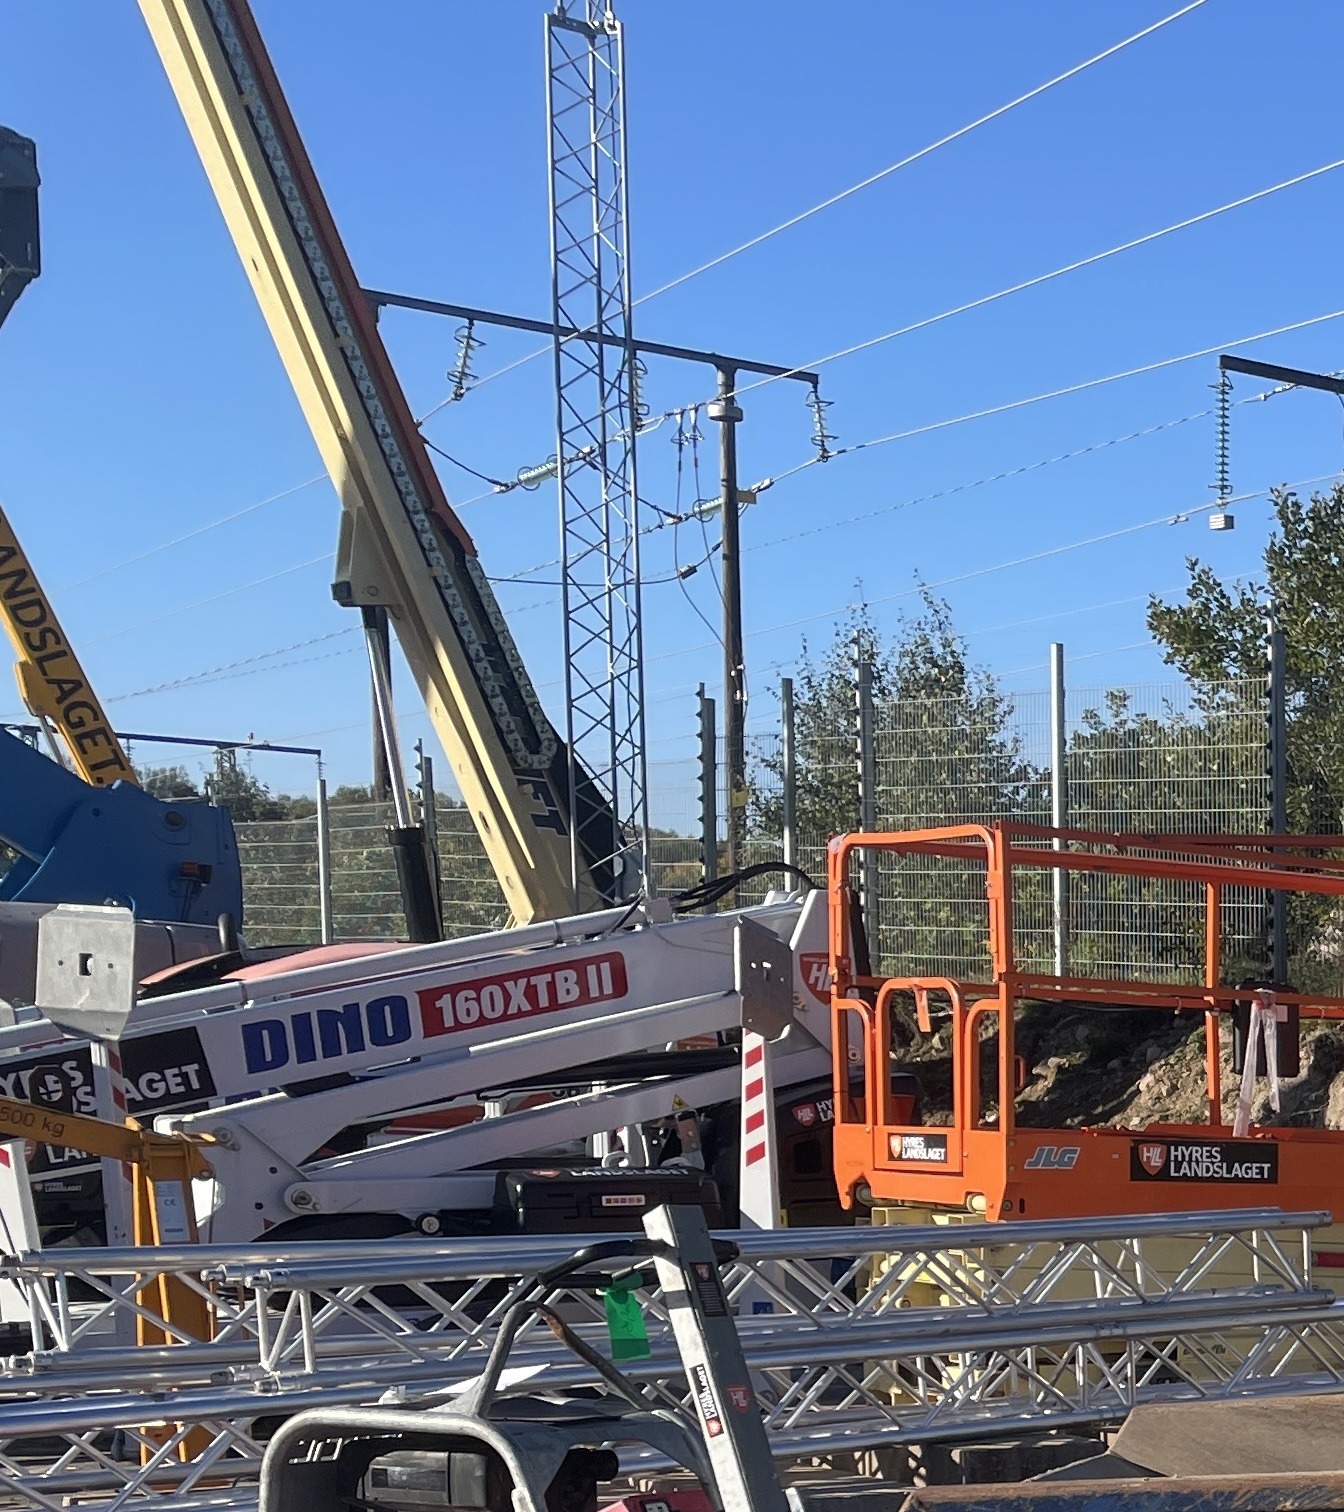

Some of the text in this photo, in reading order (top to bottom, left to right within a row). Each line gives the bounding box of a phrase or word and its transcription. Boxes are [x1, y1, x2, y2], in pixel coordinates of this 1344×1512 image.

[434, 962, 613, 1028] 160XTB II
[241, 995, 411, 1075] DINO
[41, 1117, 65, 1137] kg
[1024, 1146, 1081, 1169] JLG
[1170, 1146, 1221, 1163] HYRES
[1169, 1161, 1272, 1179] LANDSLAGET
